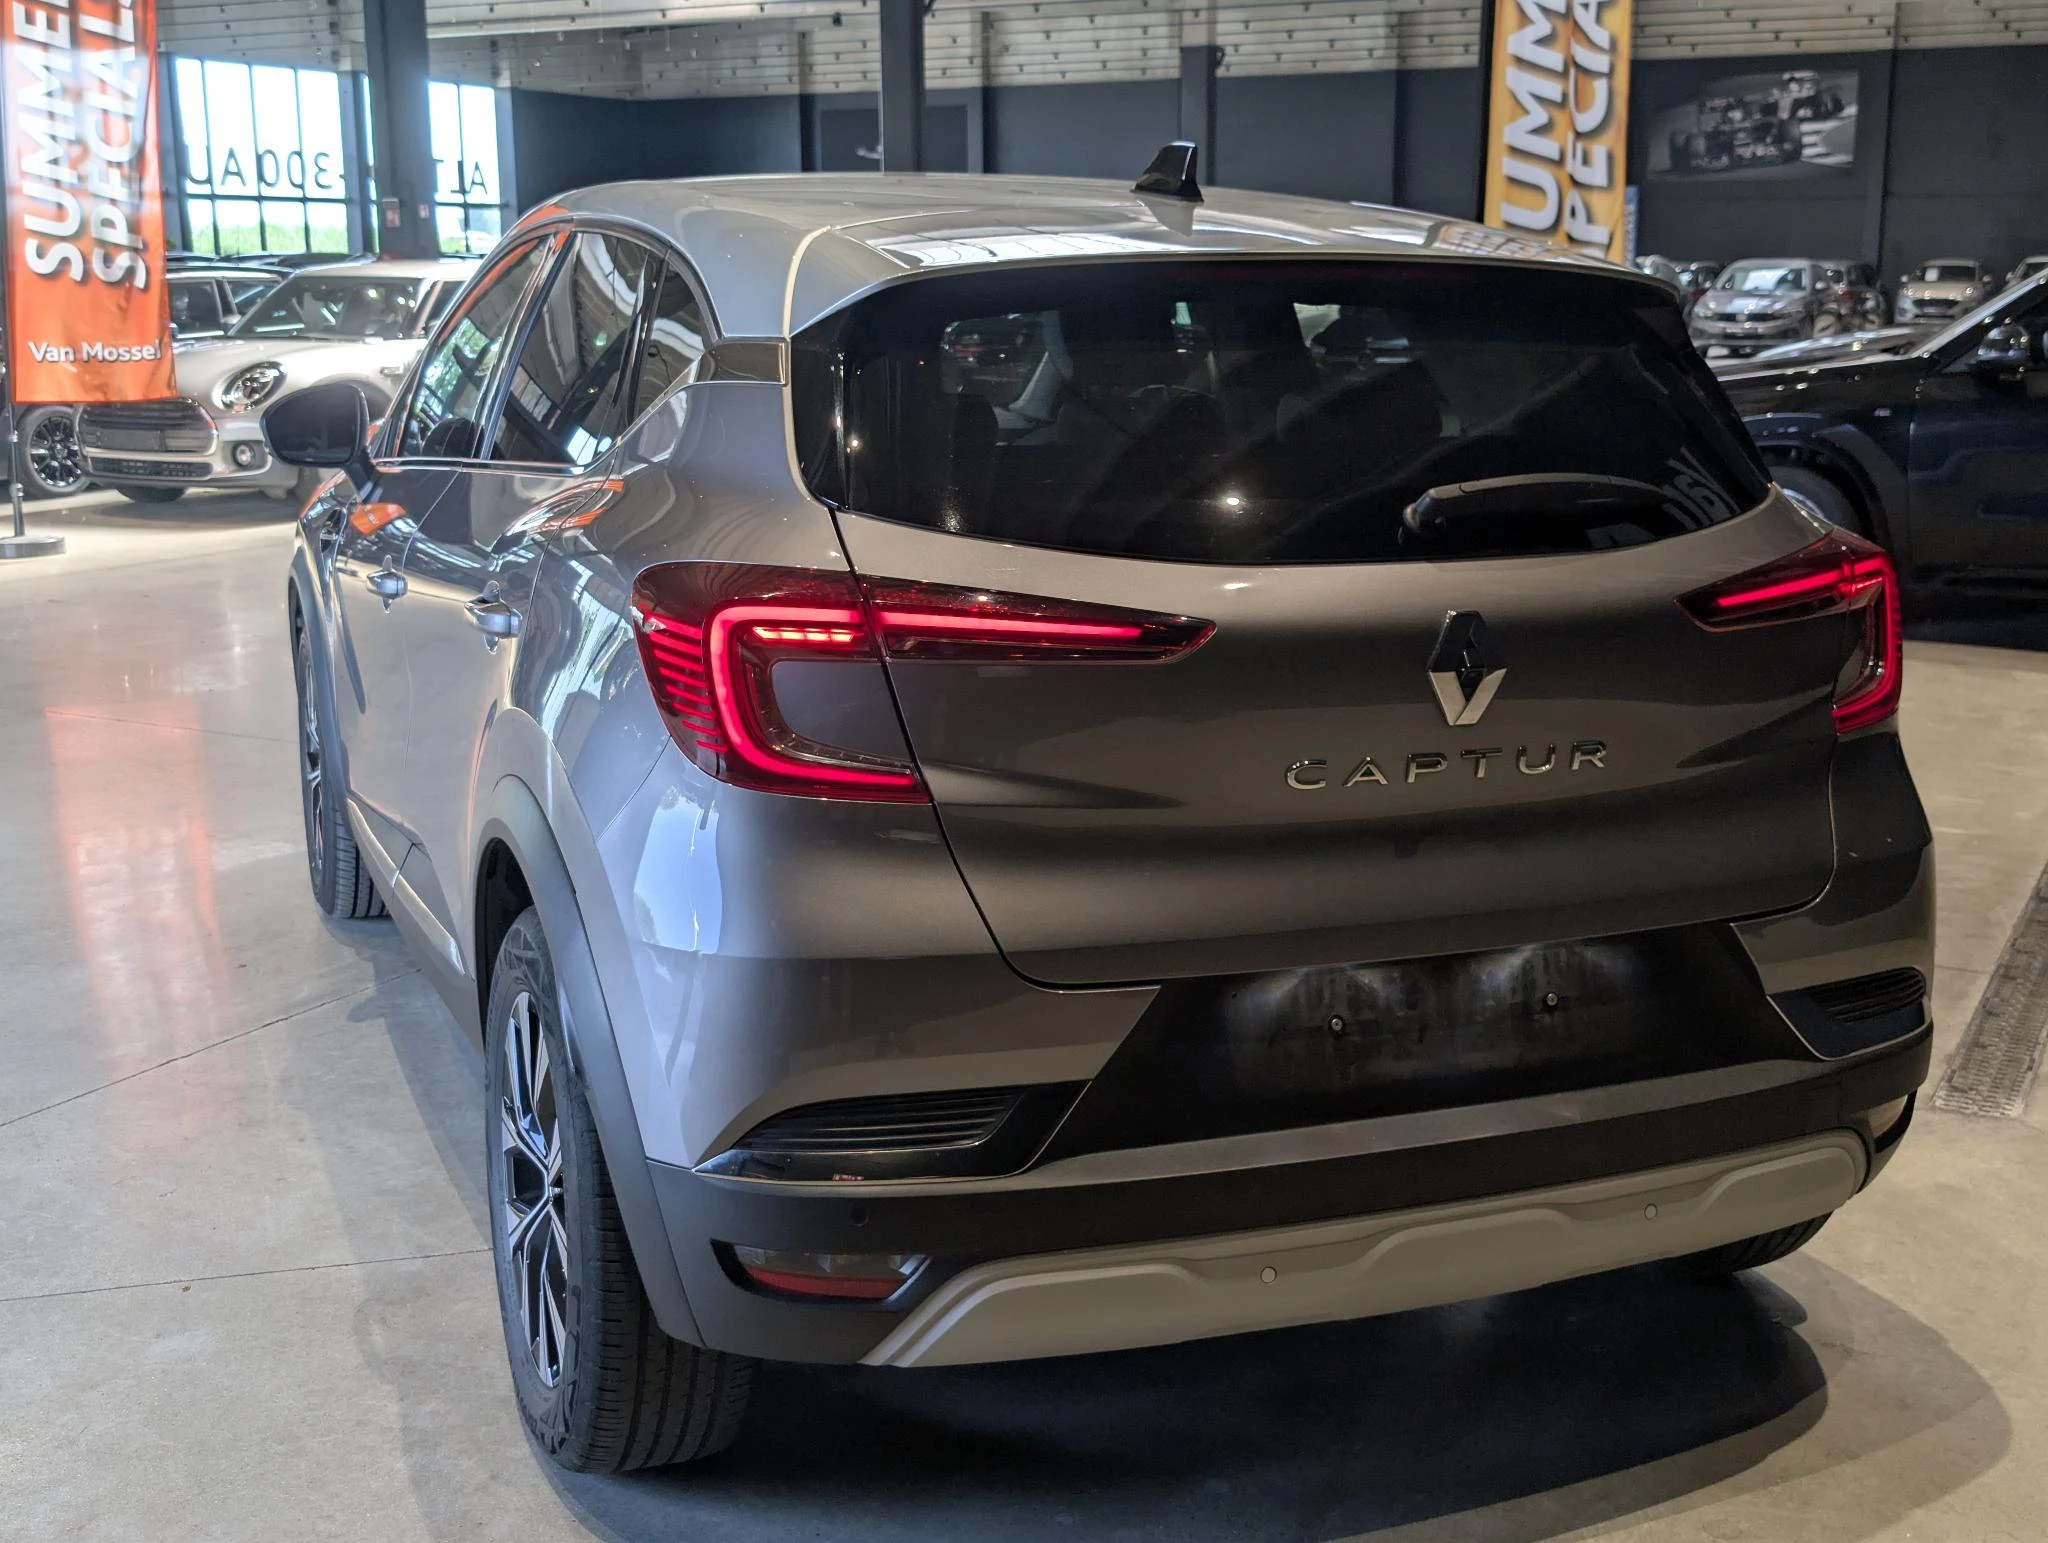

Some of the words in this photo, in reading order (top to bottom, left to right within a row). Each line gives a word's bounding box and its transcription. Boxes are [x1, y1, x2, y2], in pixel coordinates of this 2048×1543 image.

[13, 0, 84, 282] SUMME
[79, 0, 146, 289] SPECIAL
[1563, 0, 1611, 259] PECIA
[28, 341, 75, 362] Van
[81, 339, 161, 361] Mossel
[1285, 740, 1608, 790] CAPTUR
